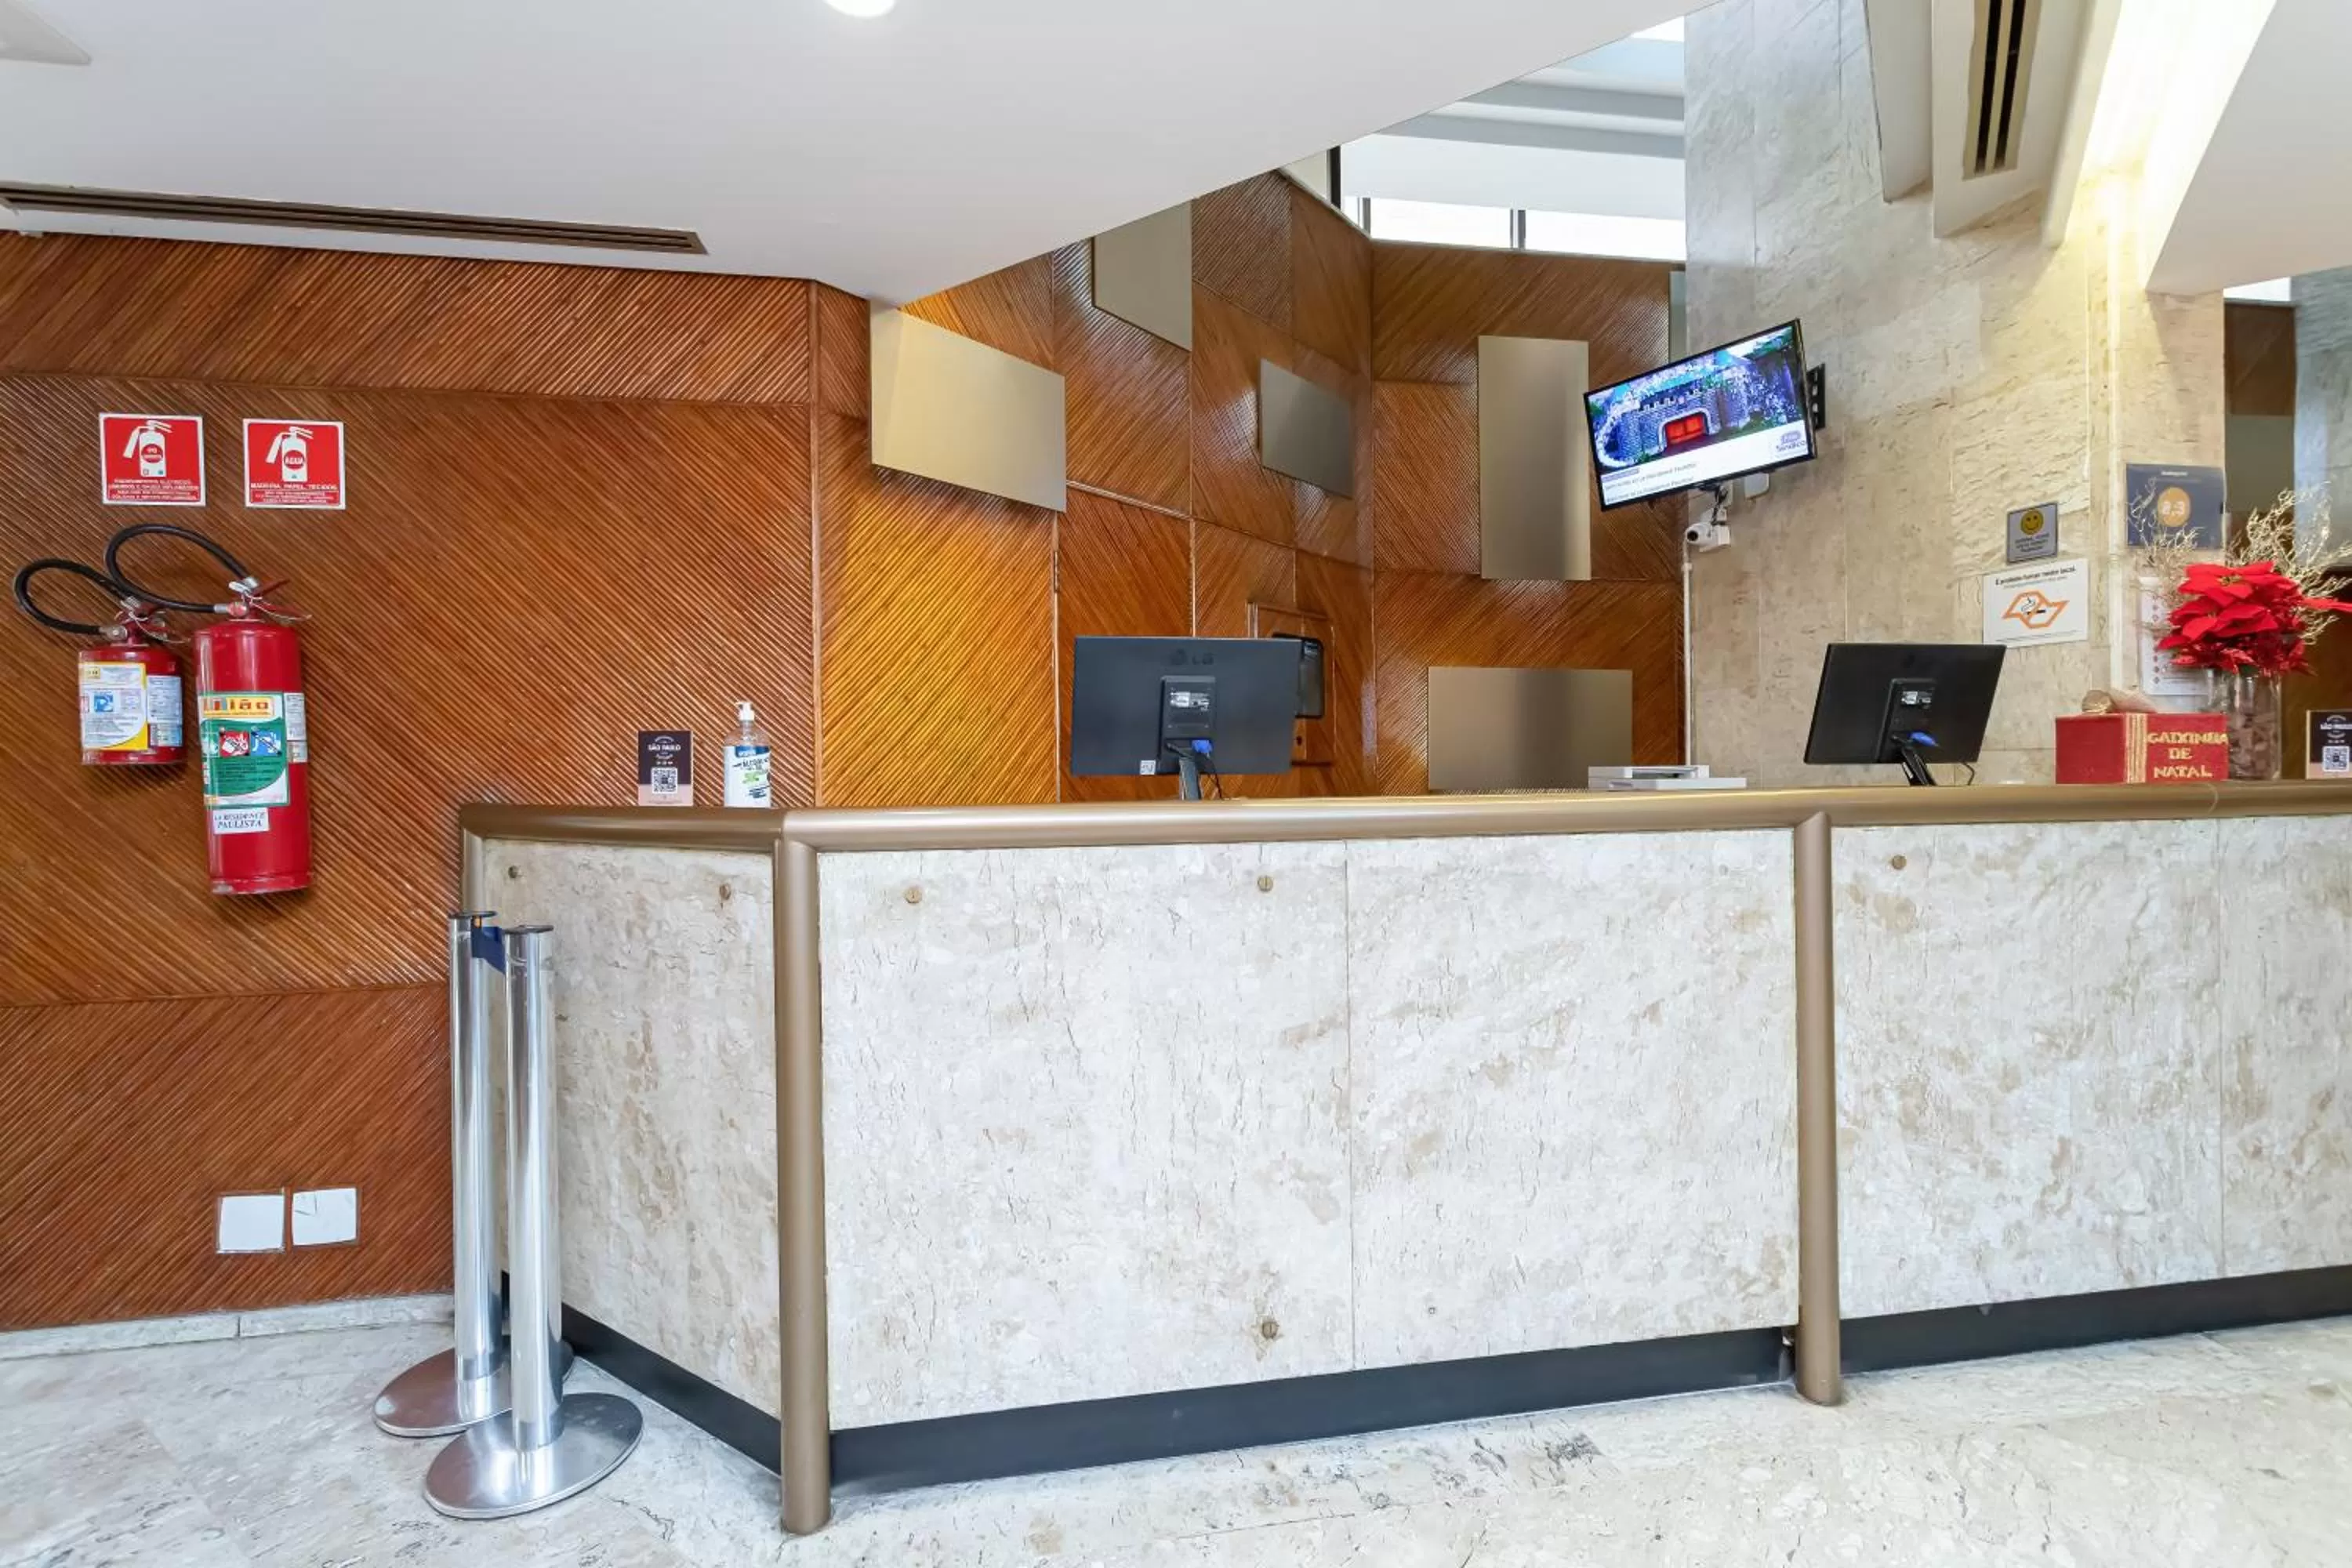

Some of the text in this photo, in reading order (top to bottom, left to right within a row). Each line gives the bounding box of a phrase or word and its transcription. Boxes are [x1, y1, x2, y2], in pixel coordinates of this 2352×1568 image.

[2168, 747, 2193, 760] DE
[2154, 764, 2213, 779] NATAL
[217, 819, 263, 829] PAULISTA
